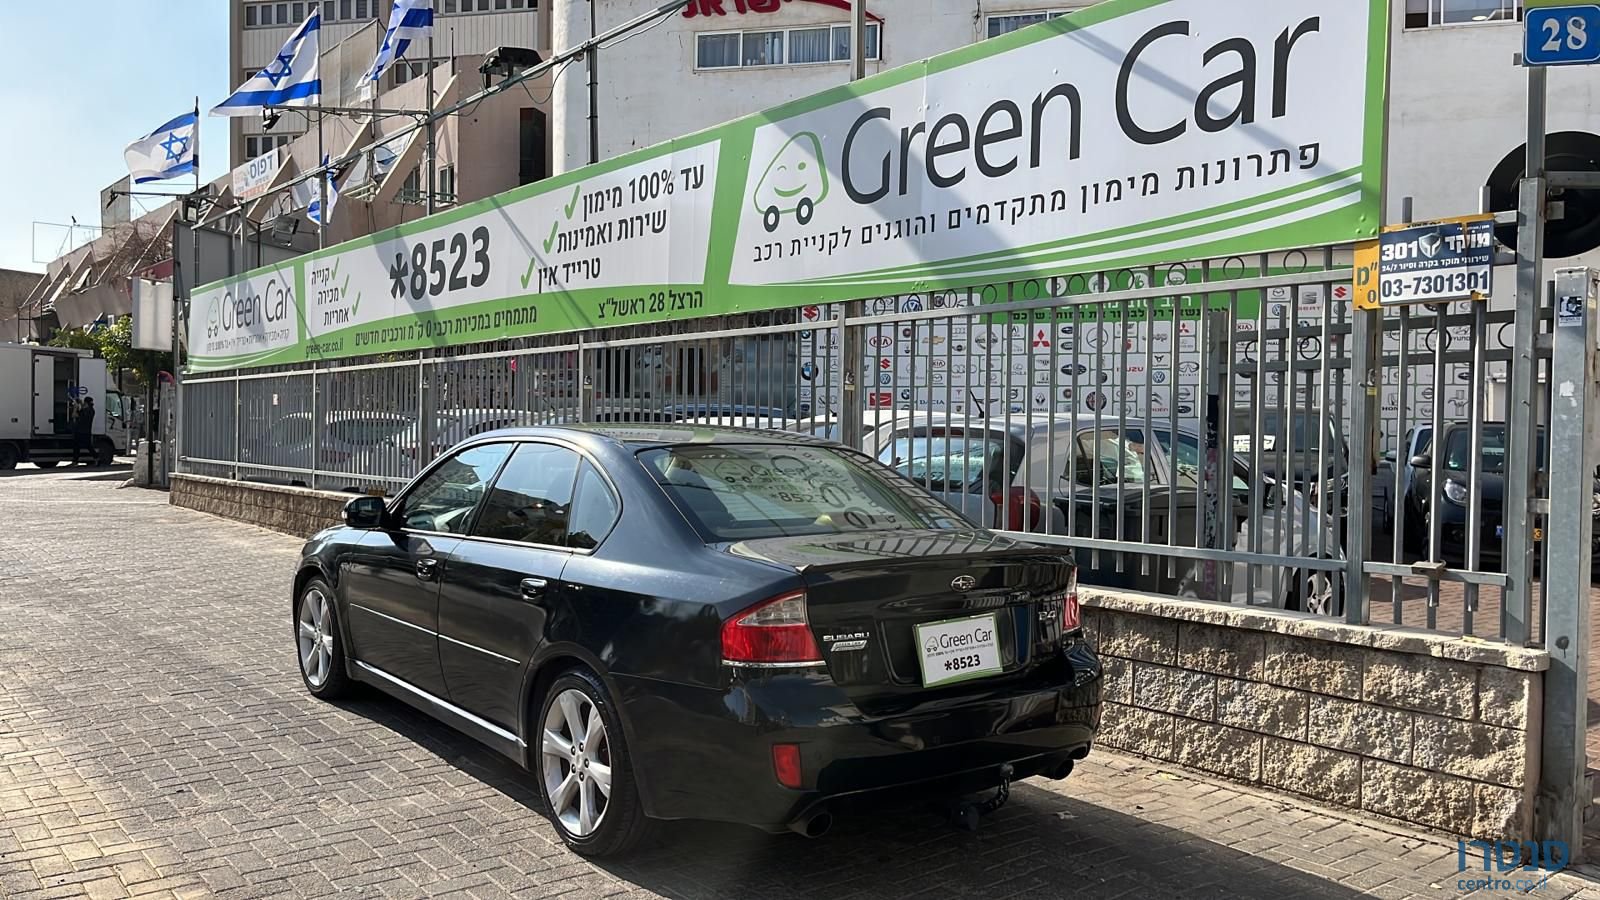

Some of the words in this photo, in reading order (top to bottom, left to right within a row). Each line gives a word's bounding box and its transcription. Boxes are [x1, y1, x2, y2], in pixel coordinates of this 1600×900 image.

[1541, 16, 1587, 52] 28
[841, 83, 1082, 205] Green
[1115, 16, 1320, 146] Car
[250, 154, 273, 179] דפוס
[680, 164, 705, 191] עד
[1175, 143, 1320, 192] פתרונות
[628, 168, 674, 203] 100%
[1081, 172, 1159, 213] מימון
[583, 186, 623, 222] מימון
[948, 190, 1066, 229] מתקדמים
[617, 209, 667, 241] שירות
[861, 212, 936, 245] והוגנים
[557, 222, 613, 254] ואמינות
[790, 225, 851, 256] לקניית
[753, 241, 782, 262] רכב
[1381, 240, 1419, 261] 301
[1440, 257, 1460, 266] מוקד
[562, 257, 601, 283] טרייד
[1382, 264, 1397, 272] 24/7
[1418, 259, 1439, 268] בקרה
[311, 267, 330, 286] קנייה
[538, 265, 558, 294] אין
[1381, 271, 1489, 298] 03-7301301
[222, 291, 261, 332] Green
[265, 278, 291, 322] Car
[317, 286, 339, 305] מכירה
[649, 292, 665, 313] 28
[669, 289, 703, 311] הרצל
[323, 307, 350, 326] אחריות
[455, 313, 491, 332] במכירת
[494, 305, 537, 327] מתמחים
[355, 330, 380, 346] חדשים
[381, 327, 406, 343] ורכבים
[426, 320, 432, 338] 0
[433, 319, 453, 336] רכבי
[305, 338, 344, 359] green-car.co.il
[823, 631, 870, 642] SUBARU
[939, 631, 973, 650] Green
[974, 628, 993, 643] Car
